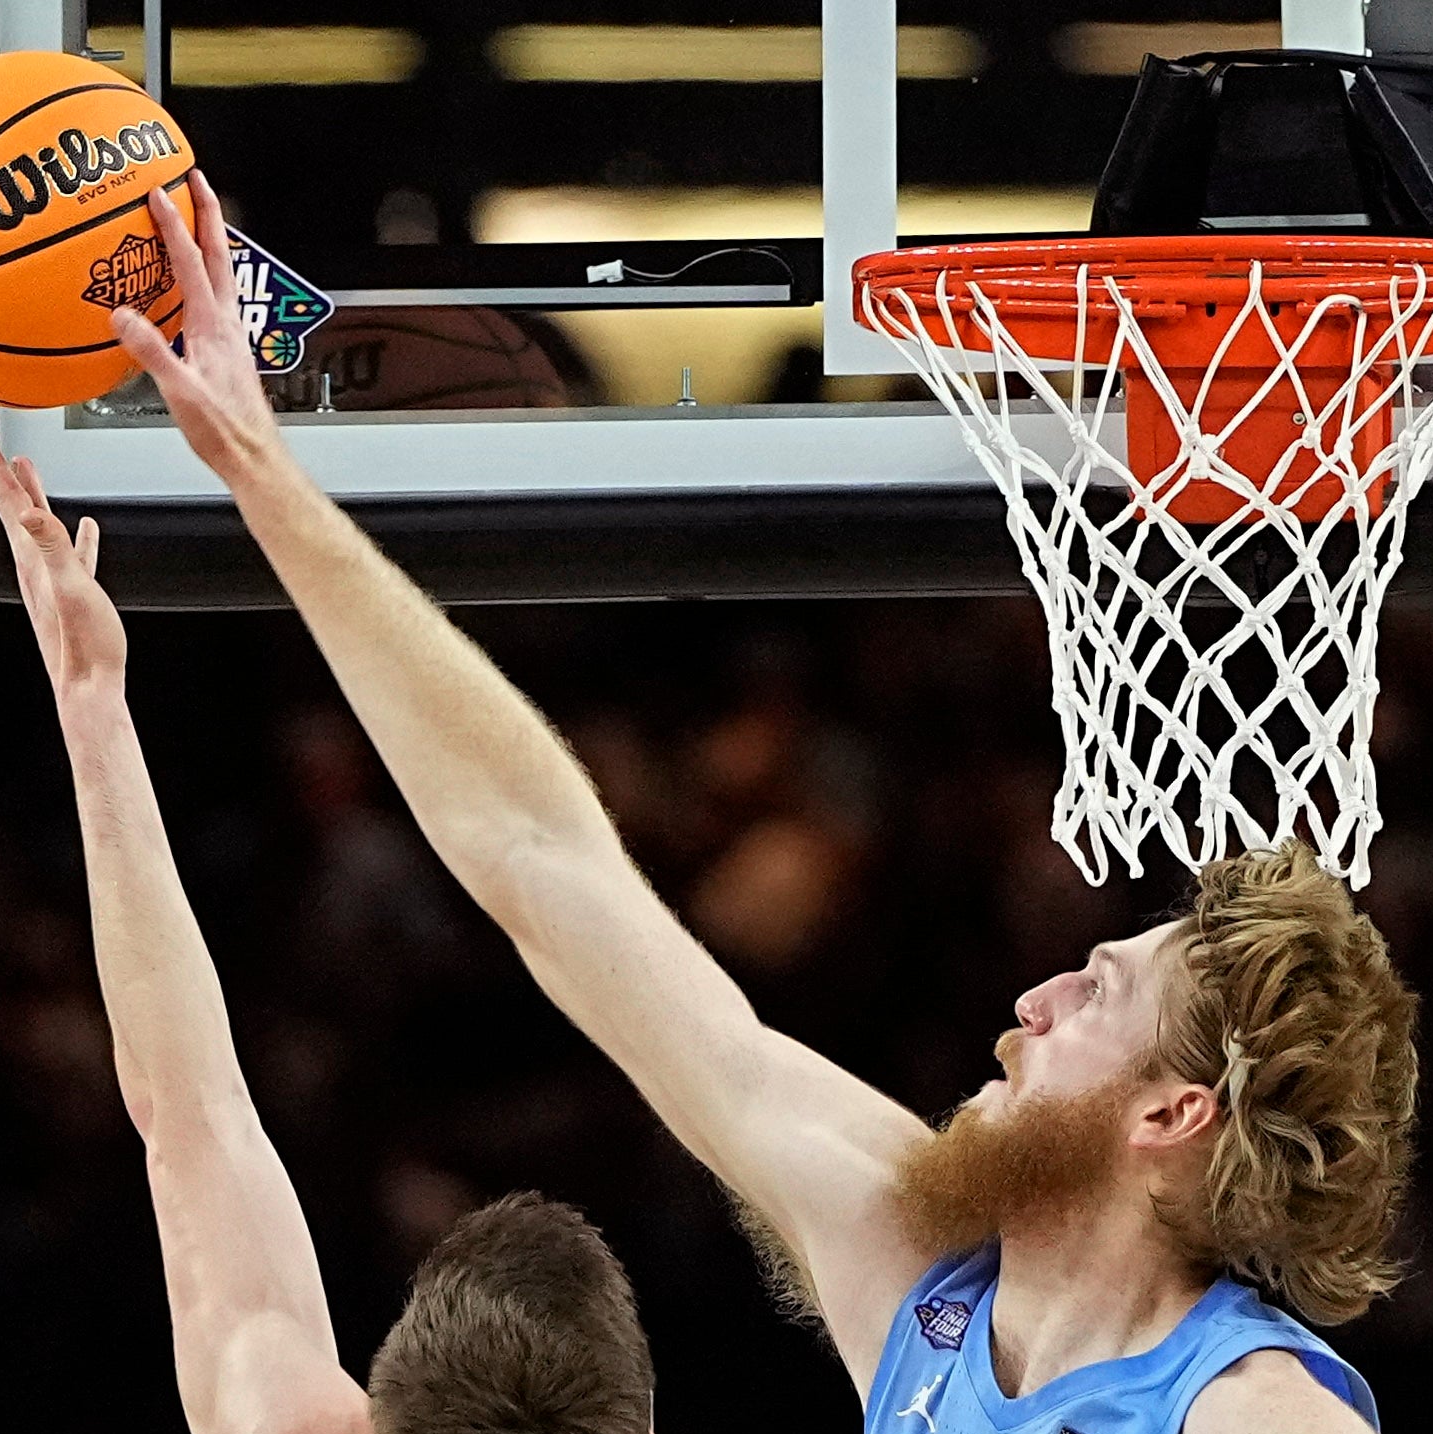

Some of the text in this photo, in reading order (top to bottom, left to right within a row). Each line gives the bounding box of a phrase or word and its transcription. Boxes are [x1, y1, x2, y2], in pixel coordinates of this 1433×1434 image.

[77, 170, 138, 205] EVO NXT
[112, 239, 161, 279] FINAL
[114, 261, 163, 303] FOUR
[928, 1317, 962, 1338] FOUR
